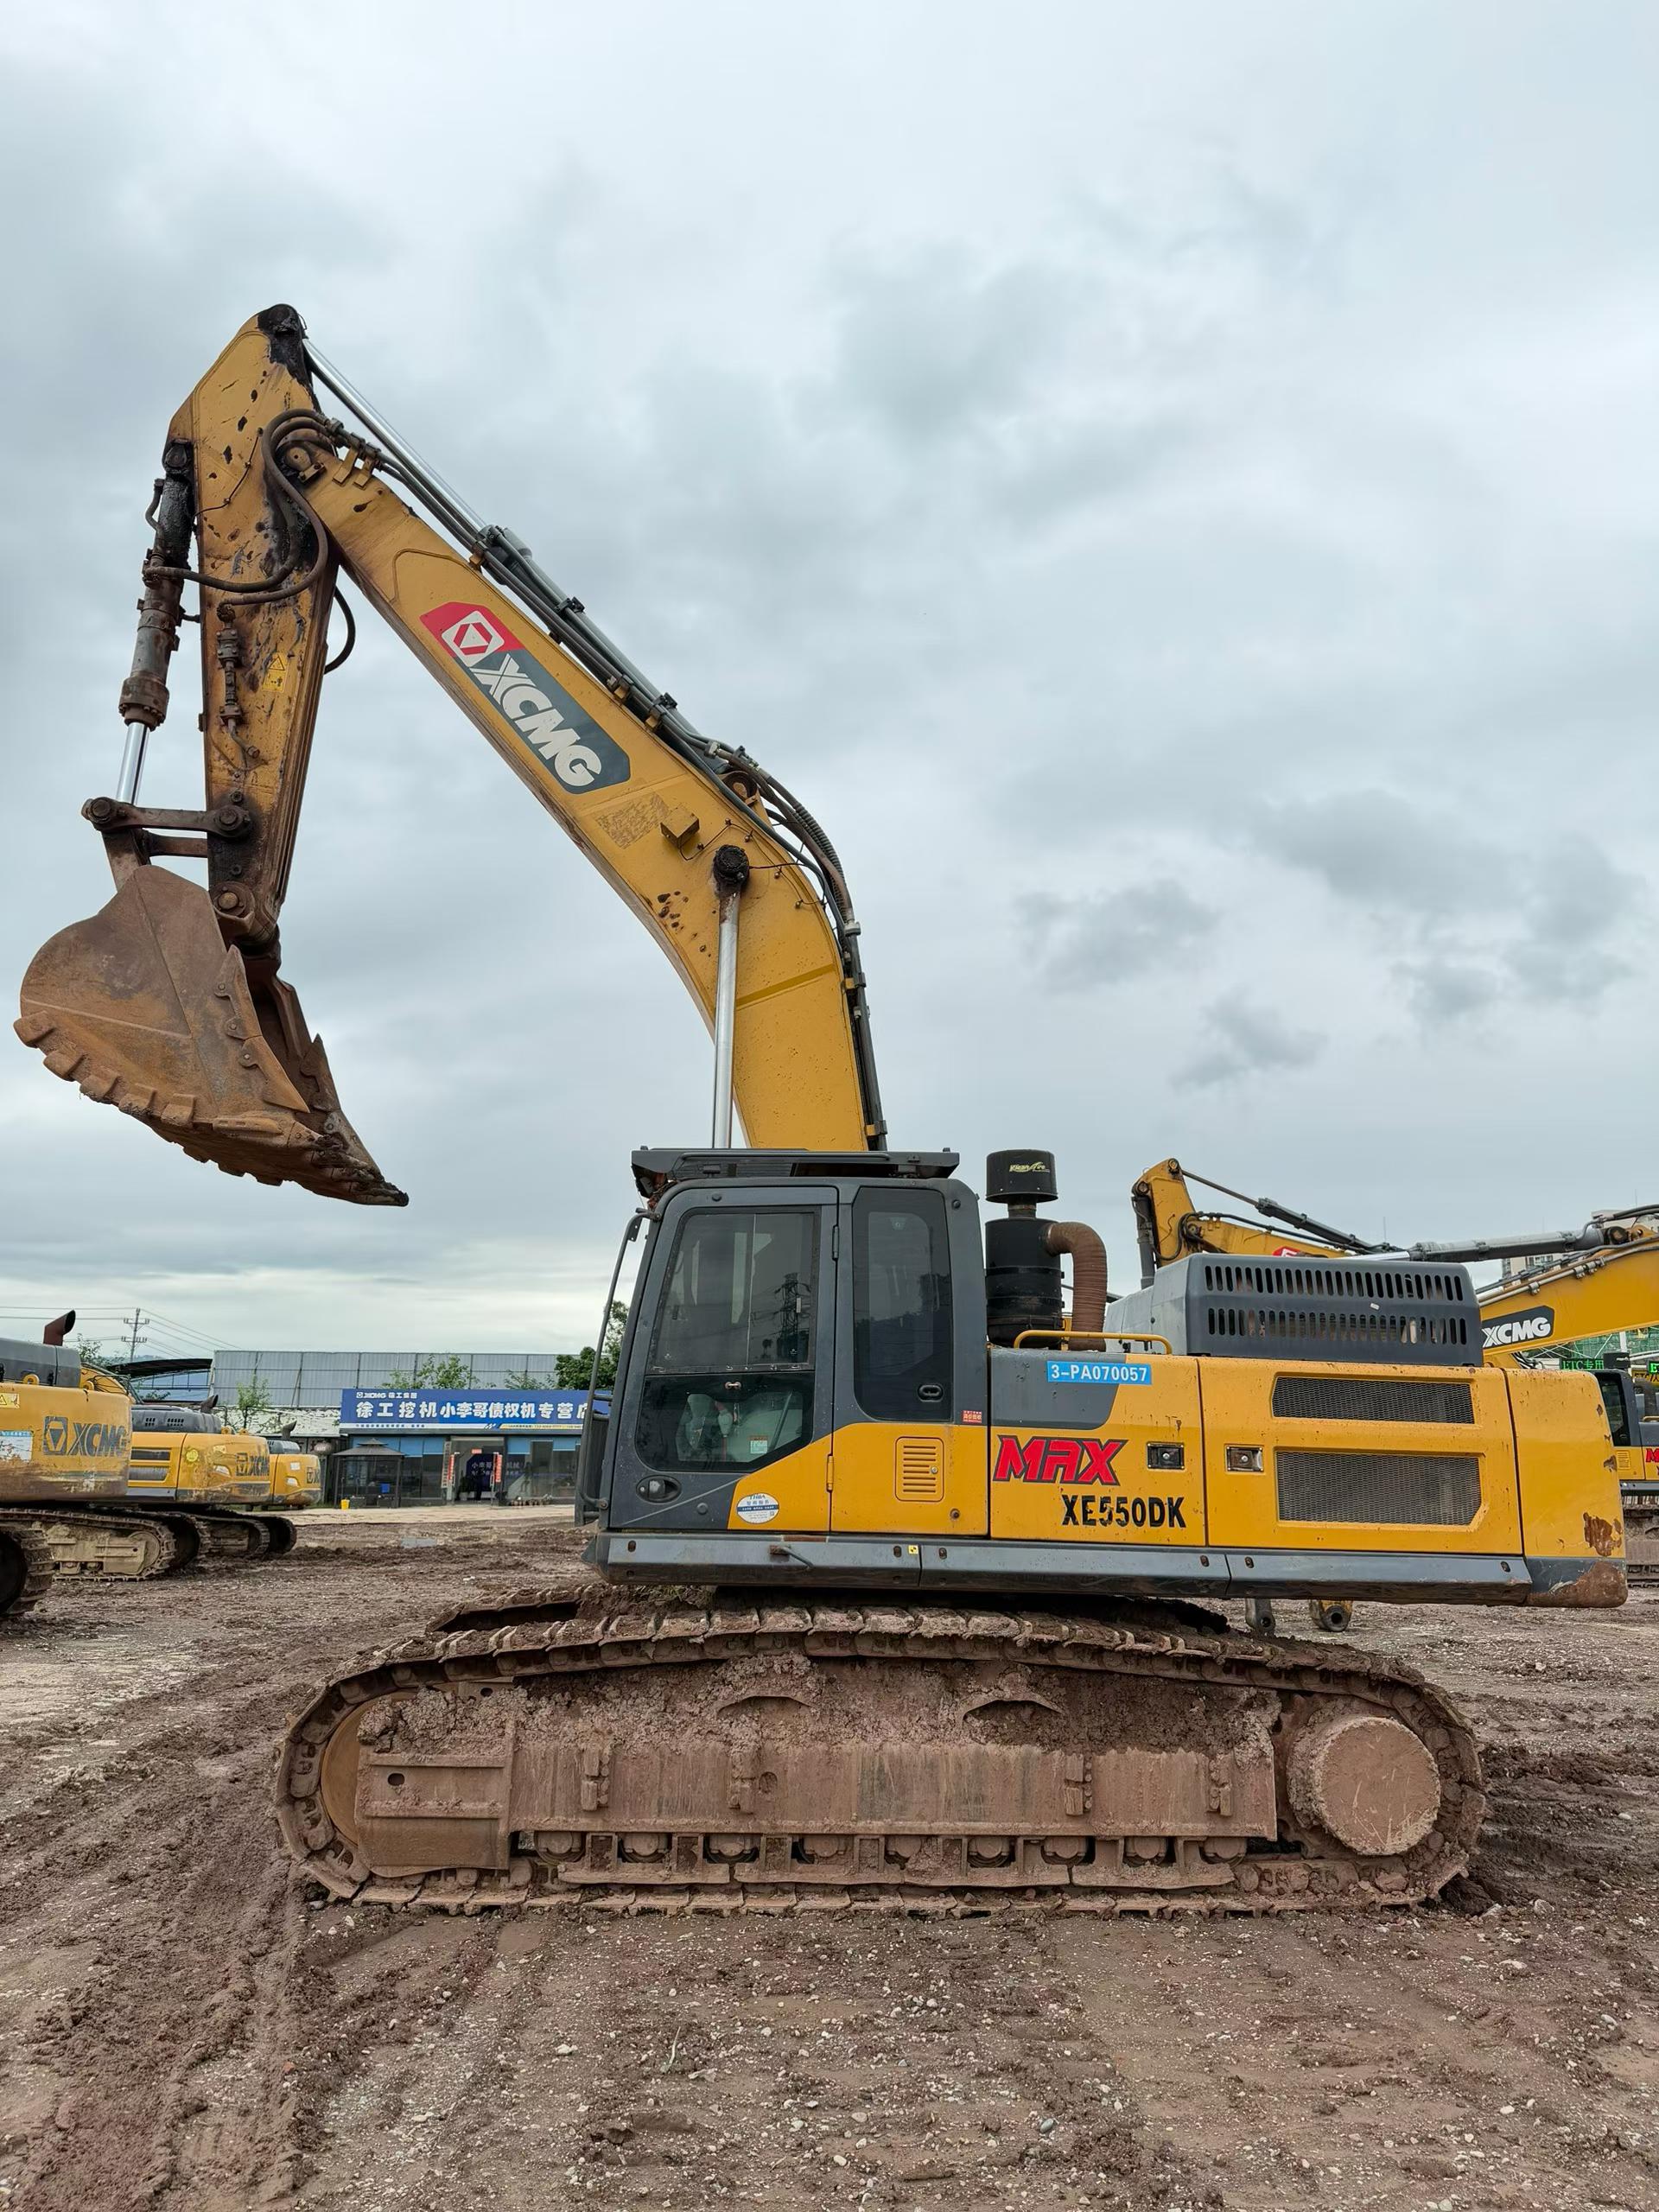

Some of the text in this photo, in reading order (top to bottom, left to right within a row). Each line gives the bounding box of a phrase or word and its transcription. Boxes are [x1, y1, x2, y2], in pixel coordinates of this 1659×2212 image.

[469, 652, 602, 787] XCMG
[1482, 1316, 1551, 1349] XCMG
[1051, 1363, 1147, 1382] 3-PA070057
[993, 1434, 1129, 1487] MAX
[1062, 1494, 1186, 1529] XE550DK
